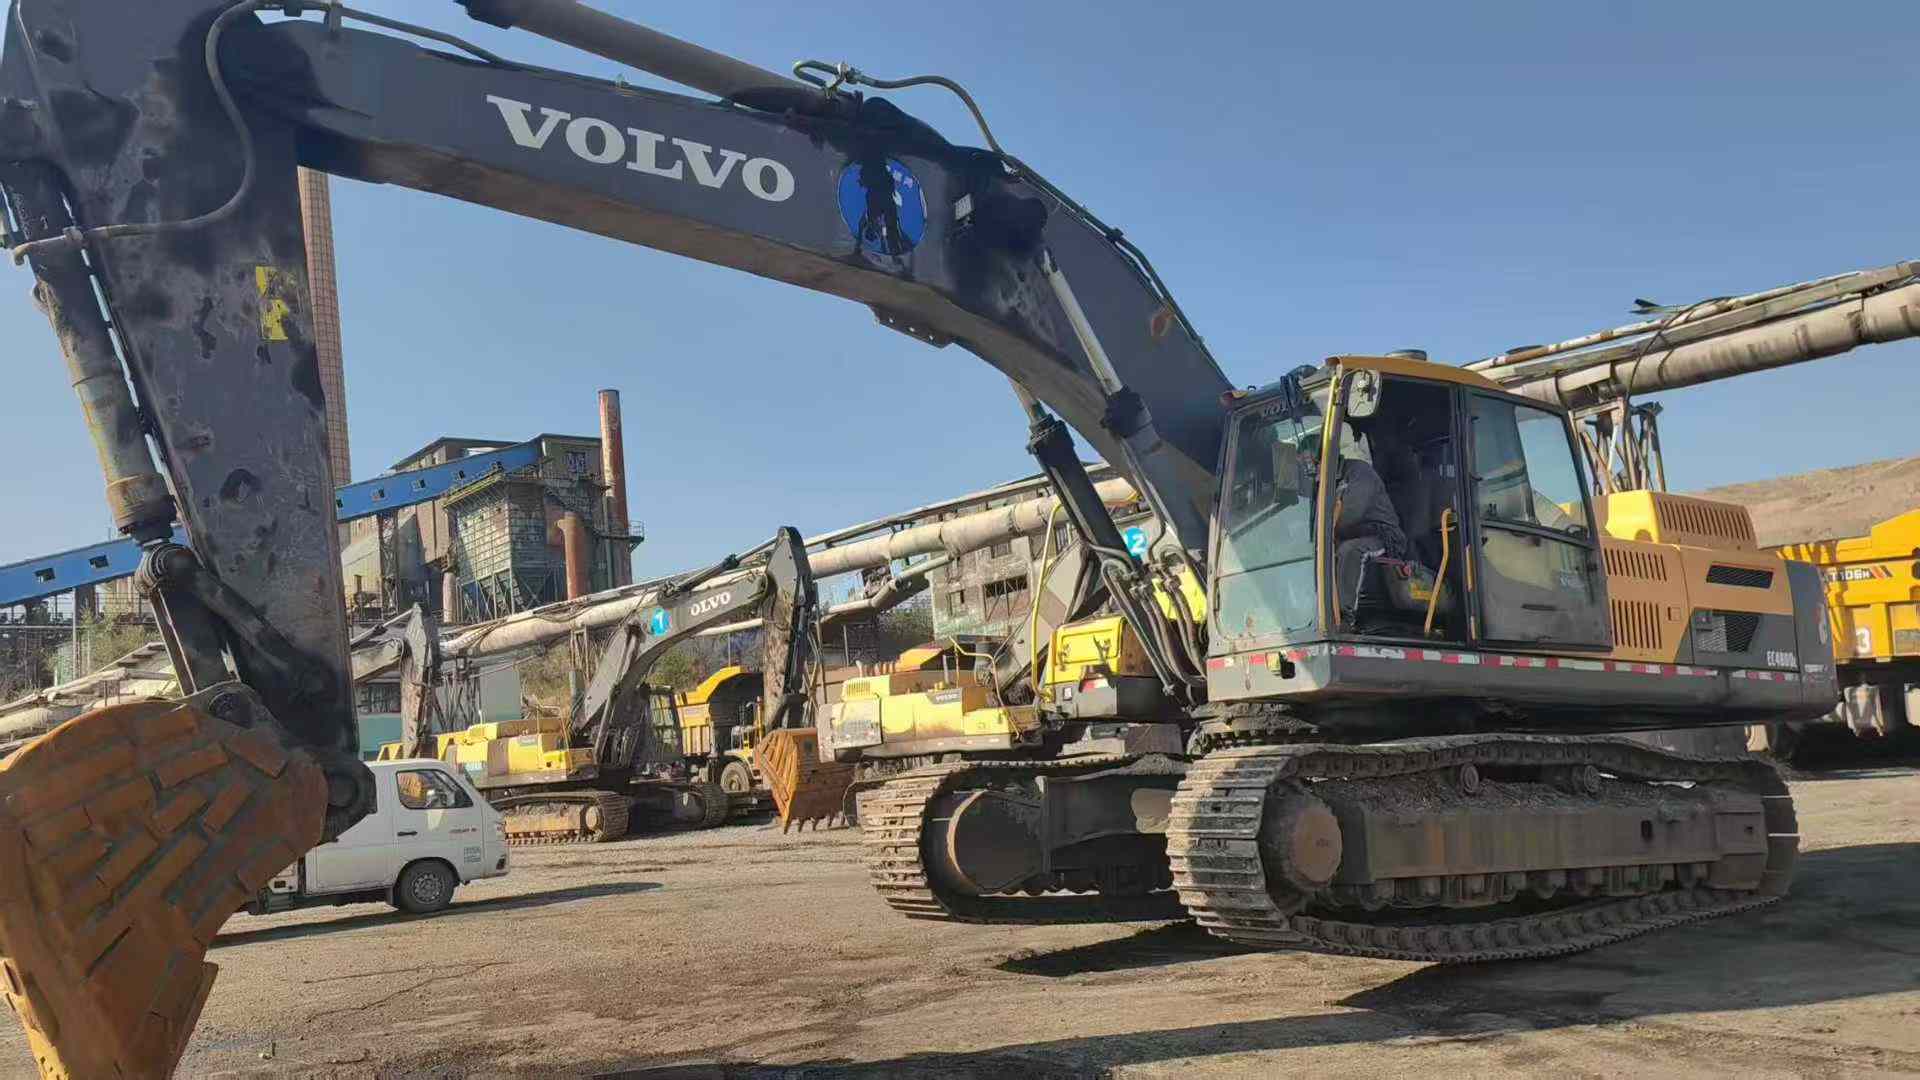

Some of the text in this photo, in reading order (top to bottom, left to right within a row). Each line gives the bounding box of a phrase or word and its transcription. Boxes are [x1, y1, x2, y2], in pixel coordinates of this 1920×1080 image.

[486, 94, 796, 202] VOLVO
[1131, 533, 1146, 553] 2
[1855, 627, 1870, 654] 3
